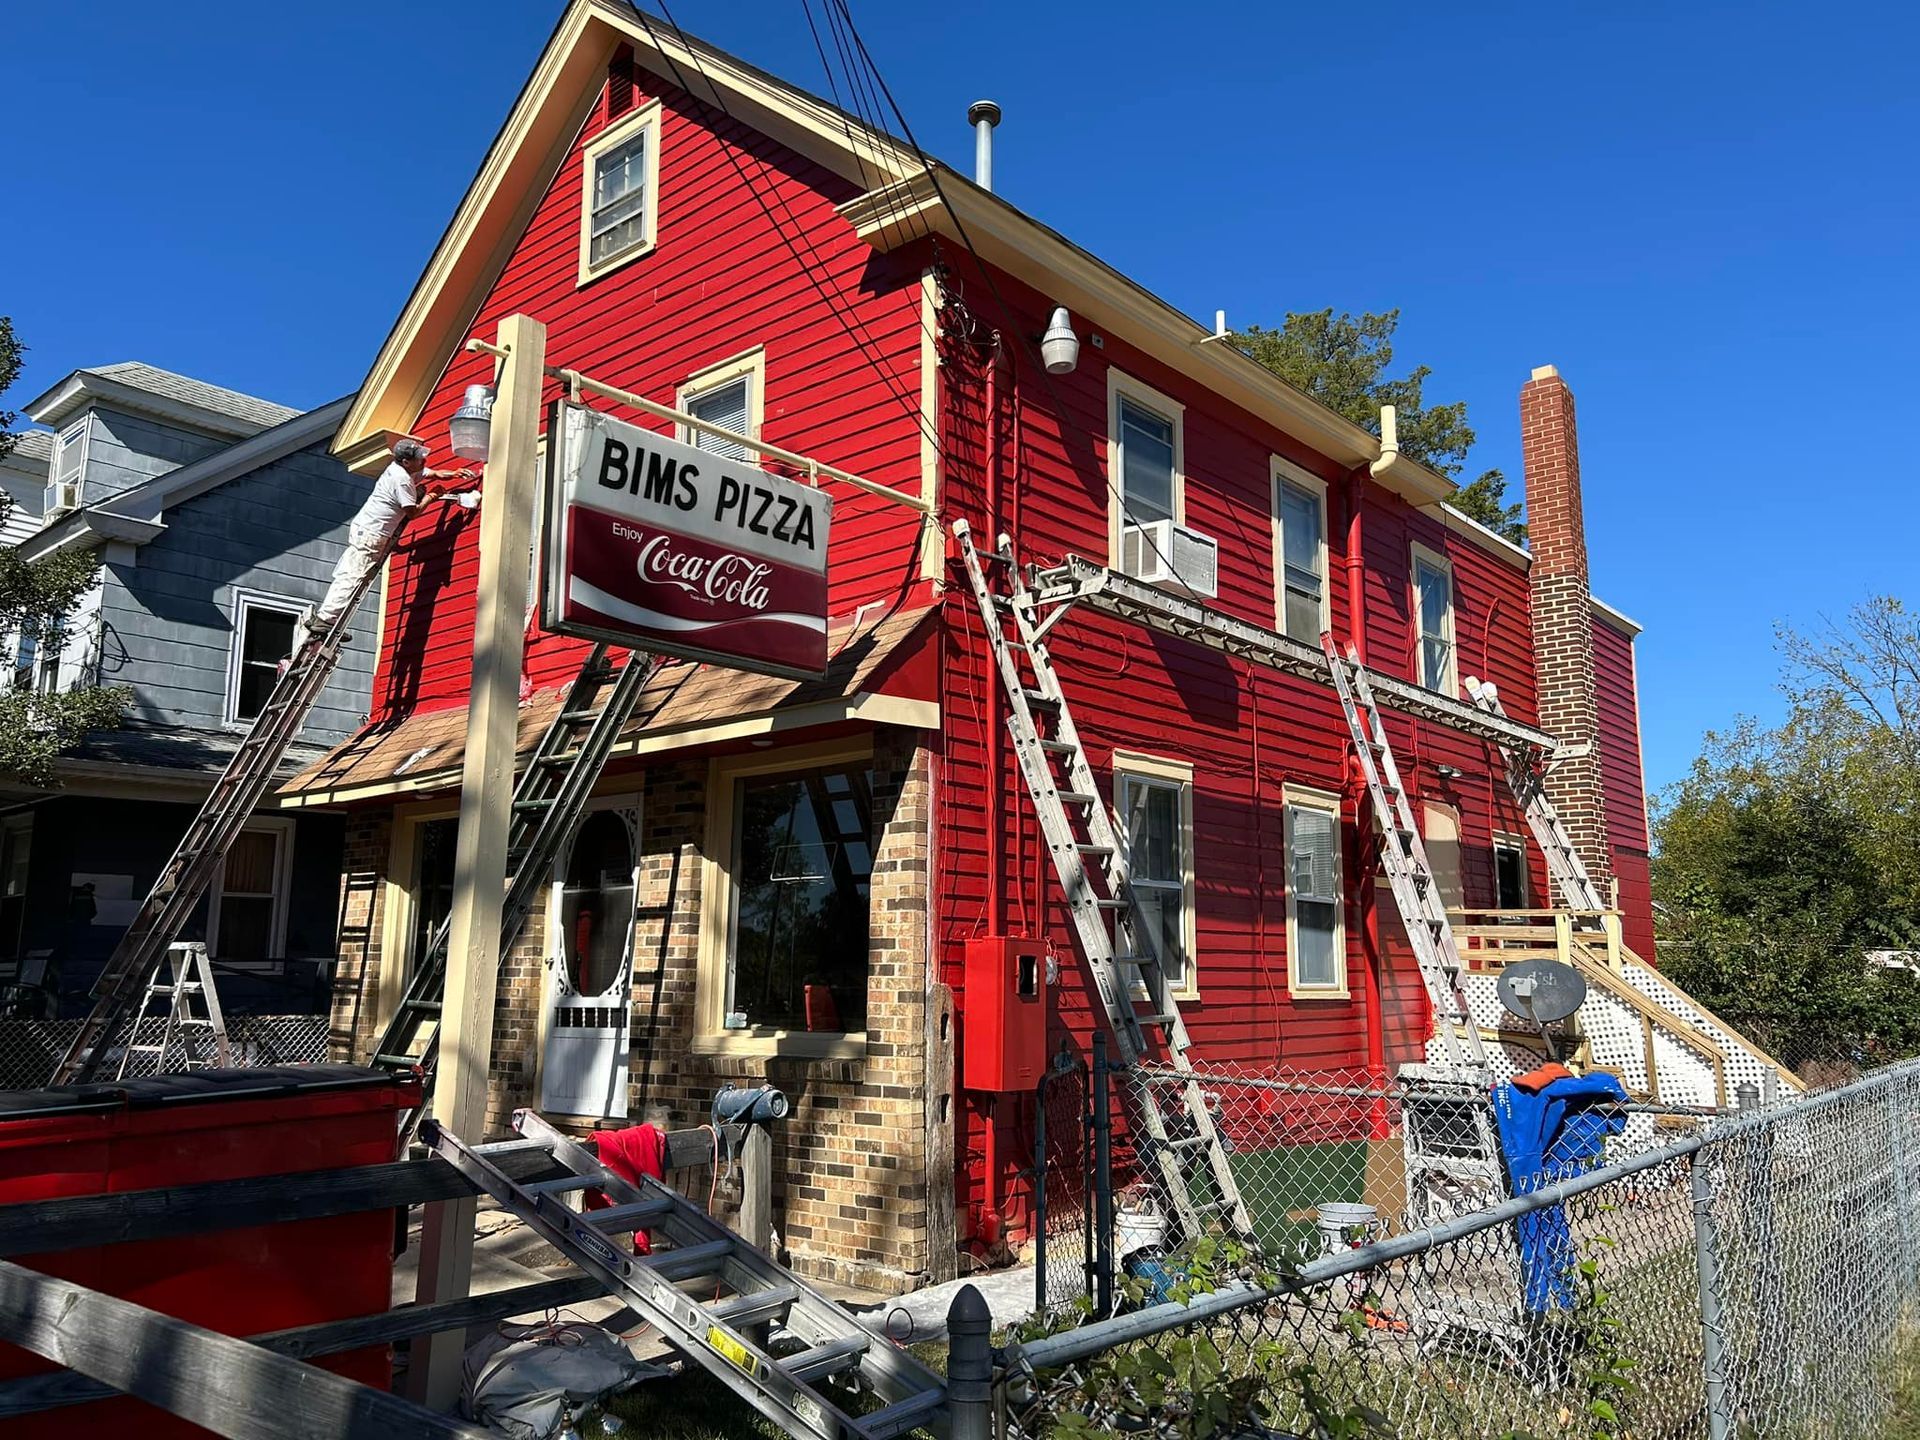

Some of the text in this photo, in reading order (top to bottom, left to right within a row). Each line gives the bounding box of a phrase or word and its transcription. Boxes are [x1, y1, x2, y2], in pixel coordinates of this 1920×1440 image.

[598, 437, 816, 551] BIMS PIZZA
[612, 522, 644, 543] Enjoy
[636, 535, 773, 610] Coca-Cola
